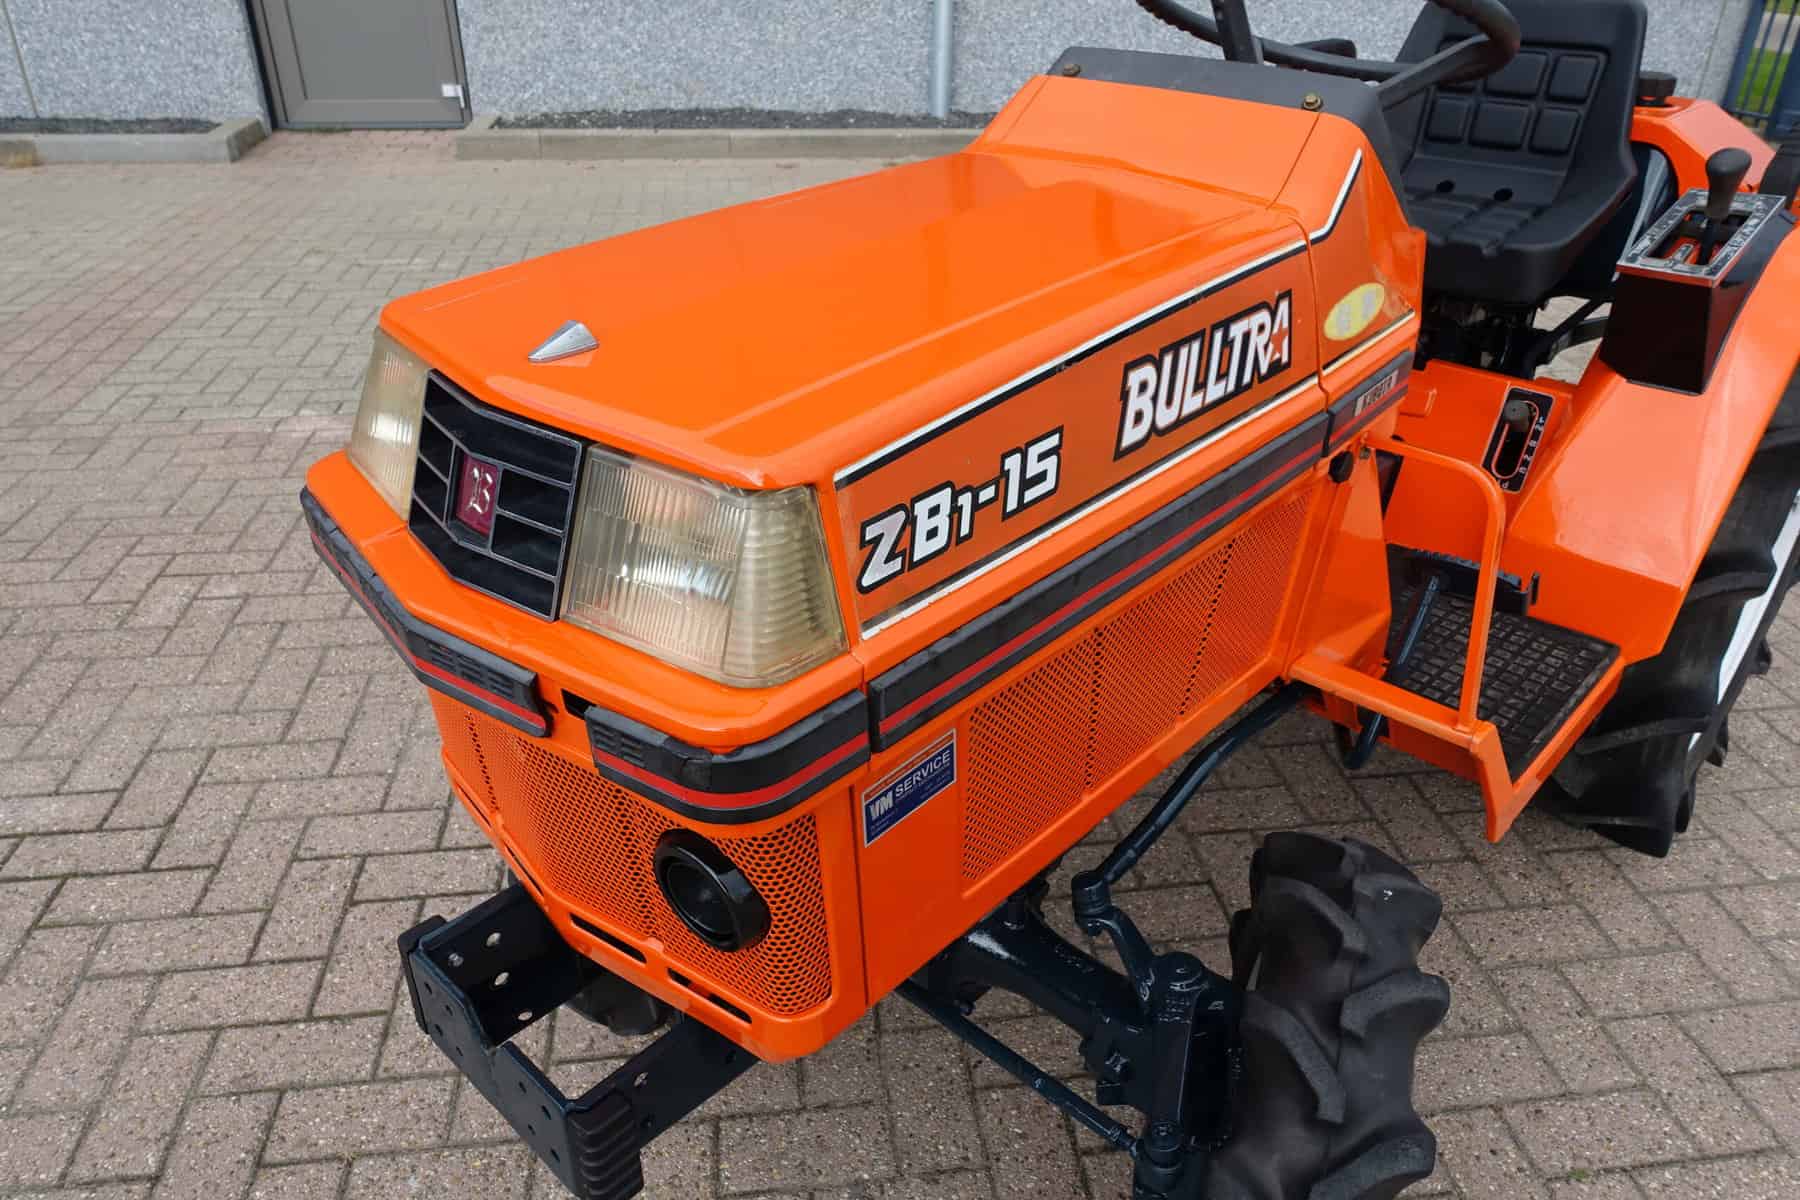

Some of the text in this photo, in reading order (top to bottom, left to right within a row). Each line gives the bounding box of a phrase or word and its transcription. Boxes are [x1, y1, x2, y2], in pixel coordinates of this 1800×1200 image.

[1115, 291, 1292, 458] BULLTRA
[858, 427, 1062, 592] ZB1-15
[869, 790, 894, 821] VM
[895, 749, 951, 797] SERVICE
